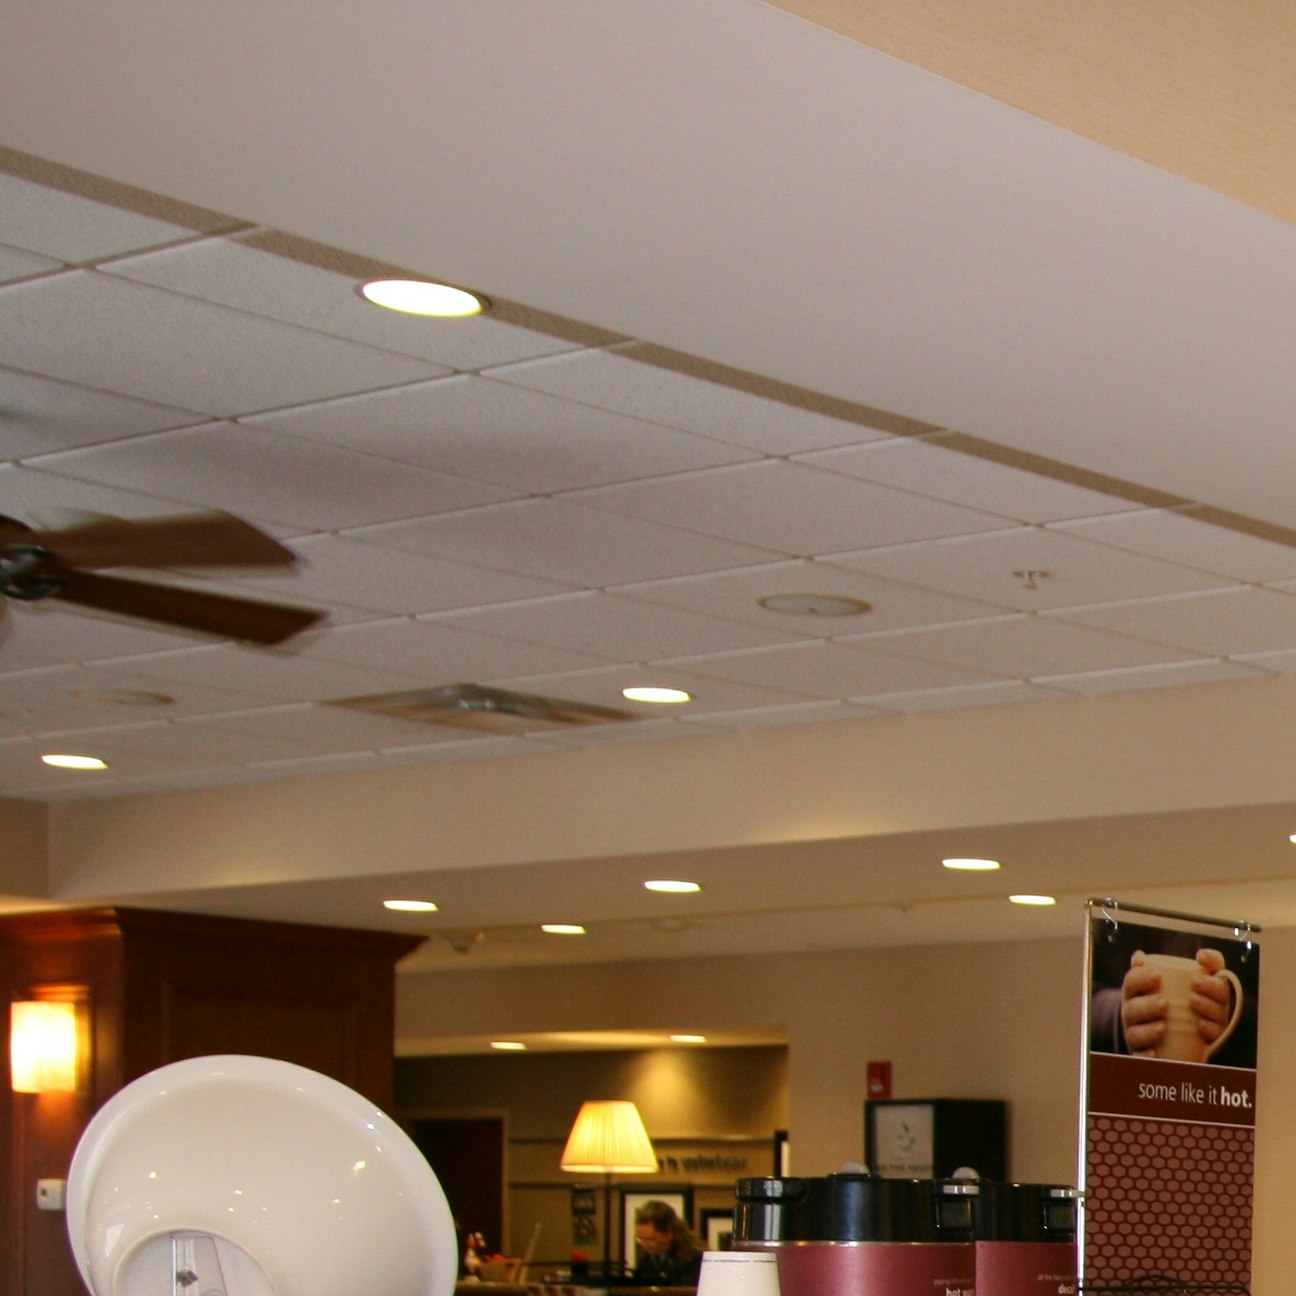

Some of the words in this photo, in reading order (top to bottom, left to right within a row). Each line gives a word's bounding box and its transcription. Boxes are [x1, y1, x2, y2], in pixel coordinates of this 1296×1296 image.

[1139, 1083, 1177, 1101] some
[1181, 1082, 1204, 1104] like
[1208, 1085, 1217, 1105] it
[1221, 1086, 1252, 1108] hot.
